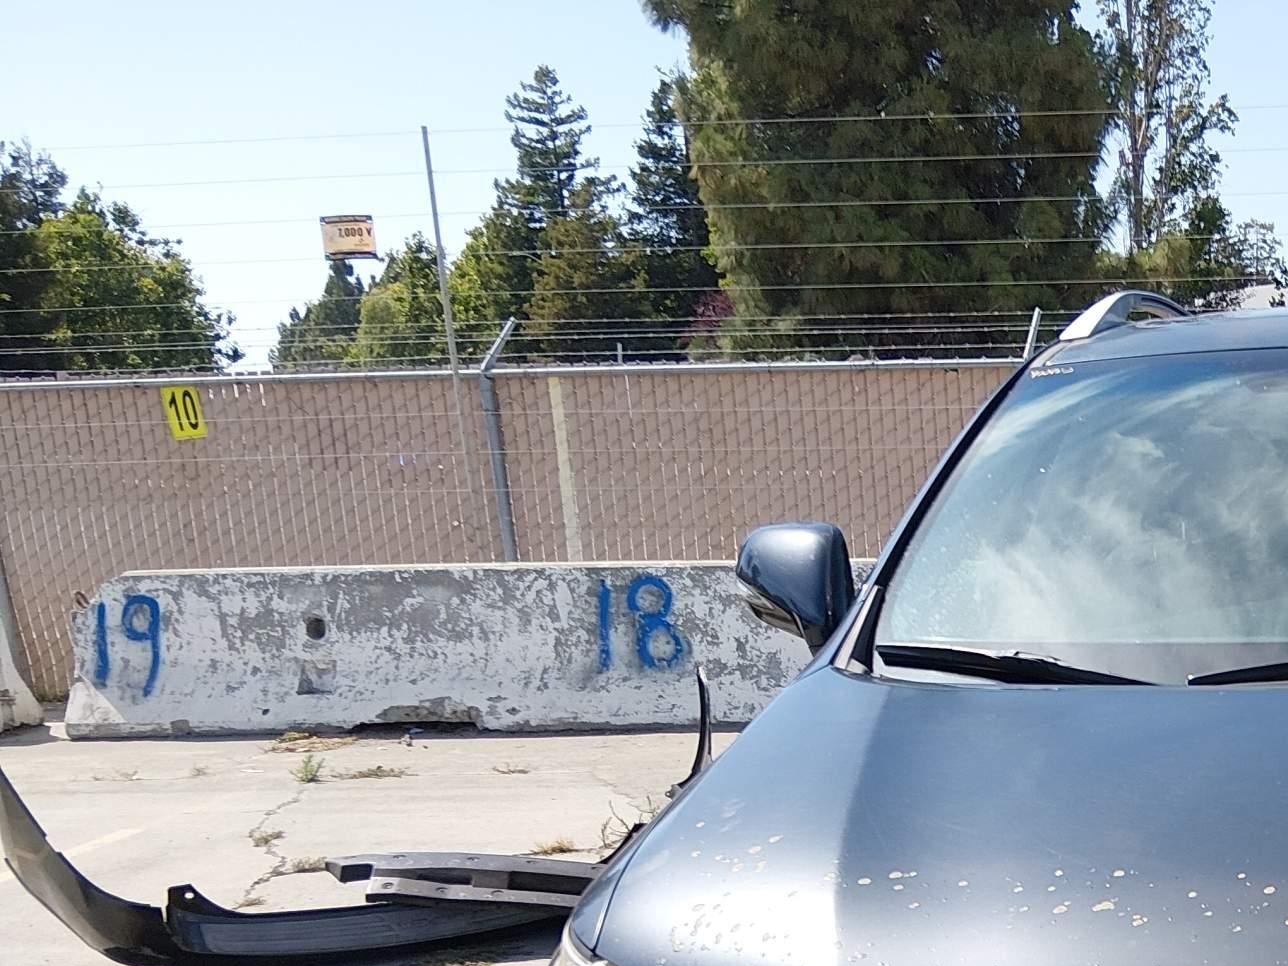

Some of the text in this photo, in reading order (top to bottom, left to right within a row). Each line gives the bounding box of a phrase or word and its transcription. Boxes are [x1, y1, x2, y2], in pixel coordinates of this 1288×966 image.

[169, 390, 198, 431] 10
[95, 594, 160, 697] 19
[597, 574, 685, 672] 18
